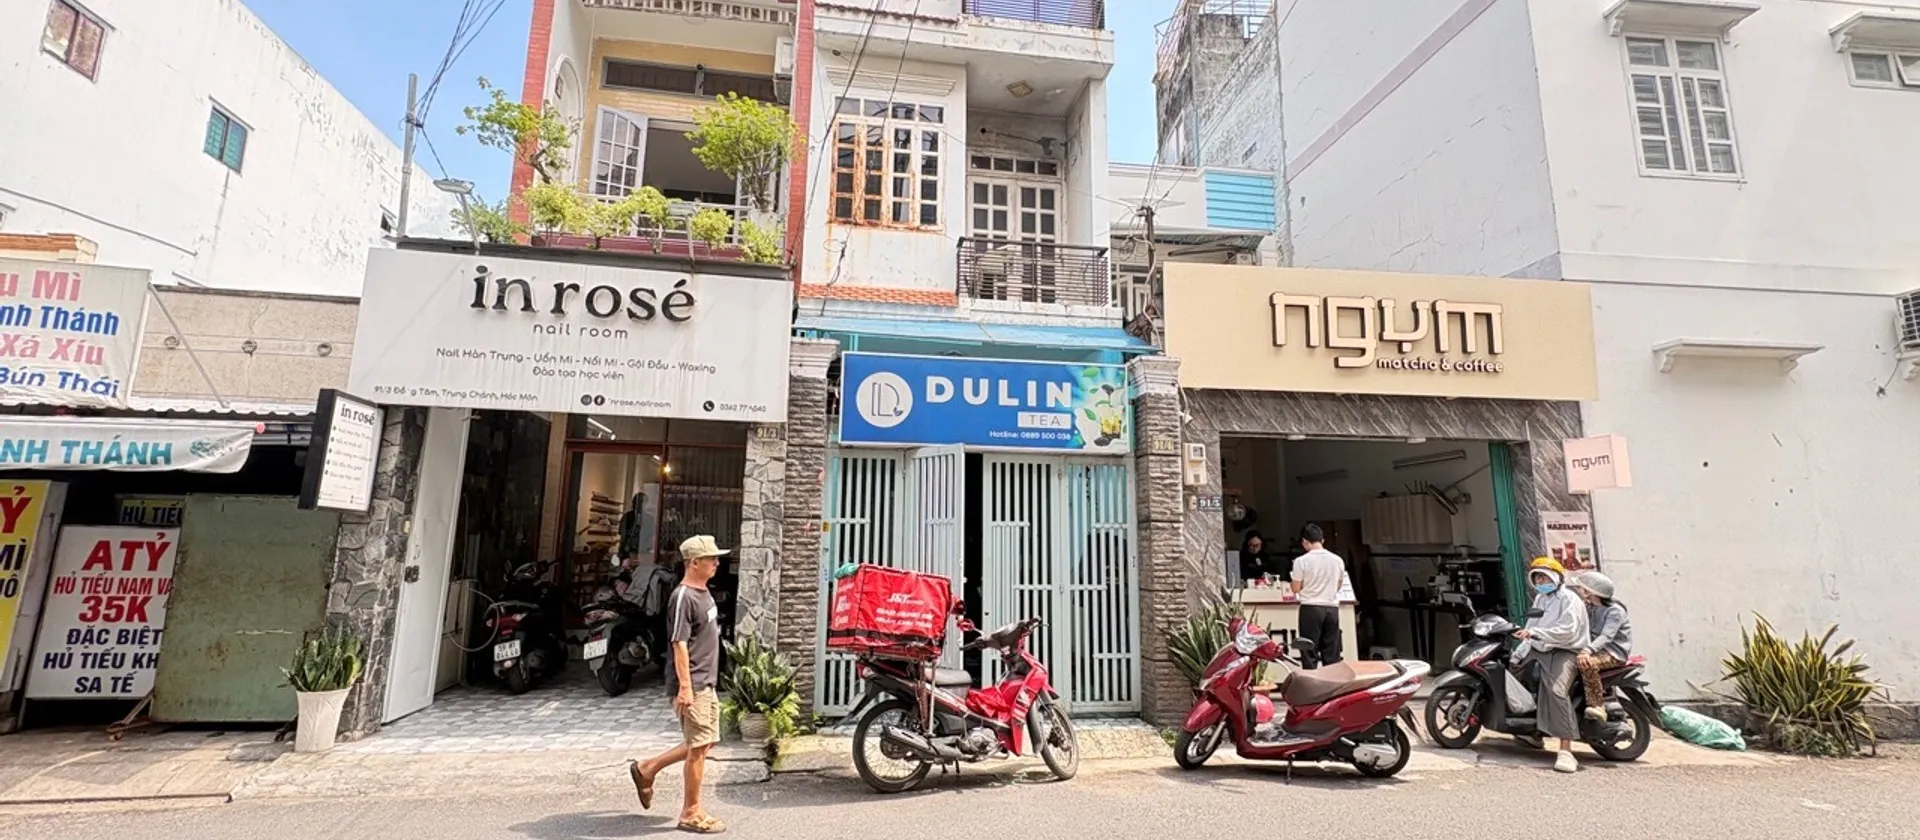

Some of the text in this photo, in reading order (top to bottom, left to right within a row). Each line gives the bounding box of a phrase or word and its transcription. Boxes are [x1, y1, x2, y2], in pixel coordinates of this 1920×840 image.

[32, 270, 81, 302] Mì
[470, 265, 696, 322] in rosé
[40, 306, 119, 335] Thánh
[533, 322, 628, 339] nail room
[0, 333, 104, 366] Xá Xíu
[436, 347, 460, 358] Nail
[489, 350, 524, 363] Trung
[560, 355, 573, 364] Mi
[604, 357, 618, 367] Mi
[678, 361, 717, 374] Waxing
[1376, 356, 1504, 373] matcha & coffee
[58, 371, 120, 398] Thái
[926, 375, 1073, 408] DULIN
[341, 404, 351, 418] in
[353, 409, 375, 425] rosé
[1028, 414, 1061, 426] TEA
[757, 427, 777, 438] 91/3
[0, 434, 173, 465] NH THÁNH
[122, 500, 146, 524] HỦ
[54, 571, 76, 595] HỦ
[80, 571, 114, 595] TIẾU
[117, 577, 153, 595] NAM
[78, 595, 152, 623] 35K
[66, 624, 163, 650] ĐẶC BIỆT
[43, 647, 73, 669] HỦ
[80, 647, 126, 669] TIẾU
[75, 671, 138, 693] SA TẾ
